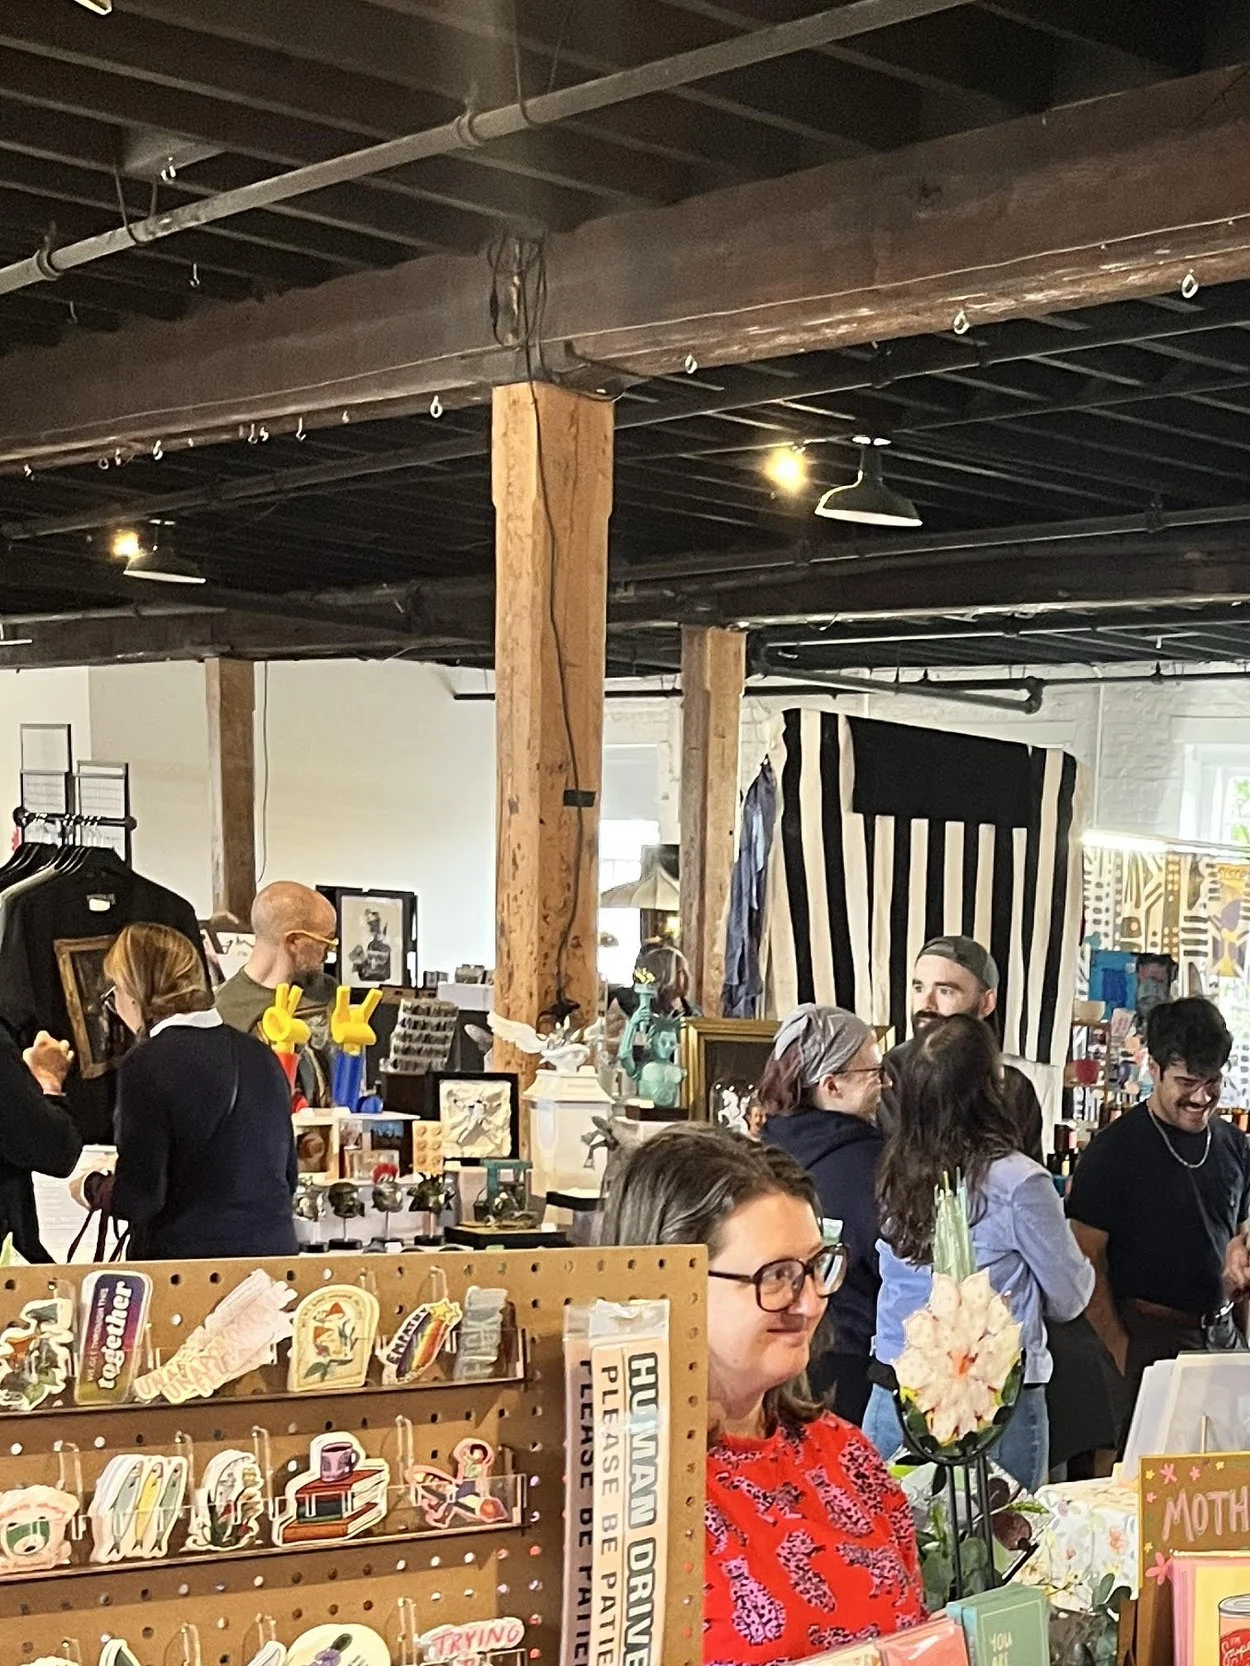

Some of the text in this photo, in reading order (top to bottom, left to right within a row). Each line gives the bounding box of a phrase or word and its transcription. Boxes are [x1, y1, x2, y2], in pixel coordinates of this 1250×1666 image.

[98, 1281, 132, 1389] together
[386, 1306, 429, 1365] EMPATHY
[601, 1365, 620, 1496] PLEASE
[628, 1352, 660, 1529] HUMAN
[601, 1513, 618, 1556] BE
[432, 1625, 522, 1656] TRYING
[989, 1631, 1012, 1652] YOU
